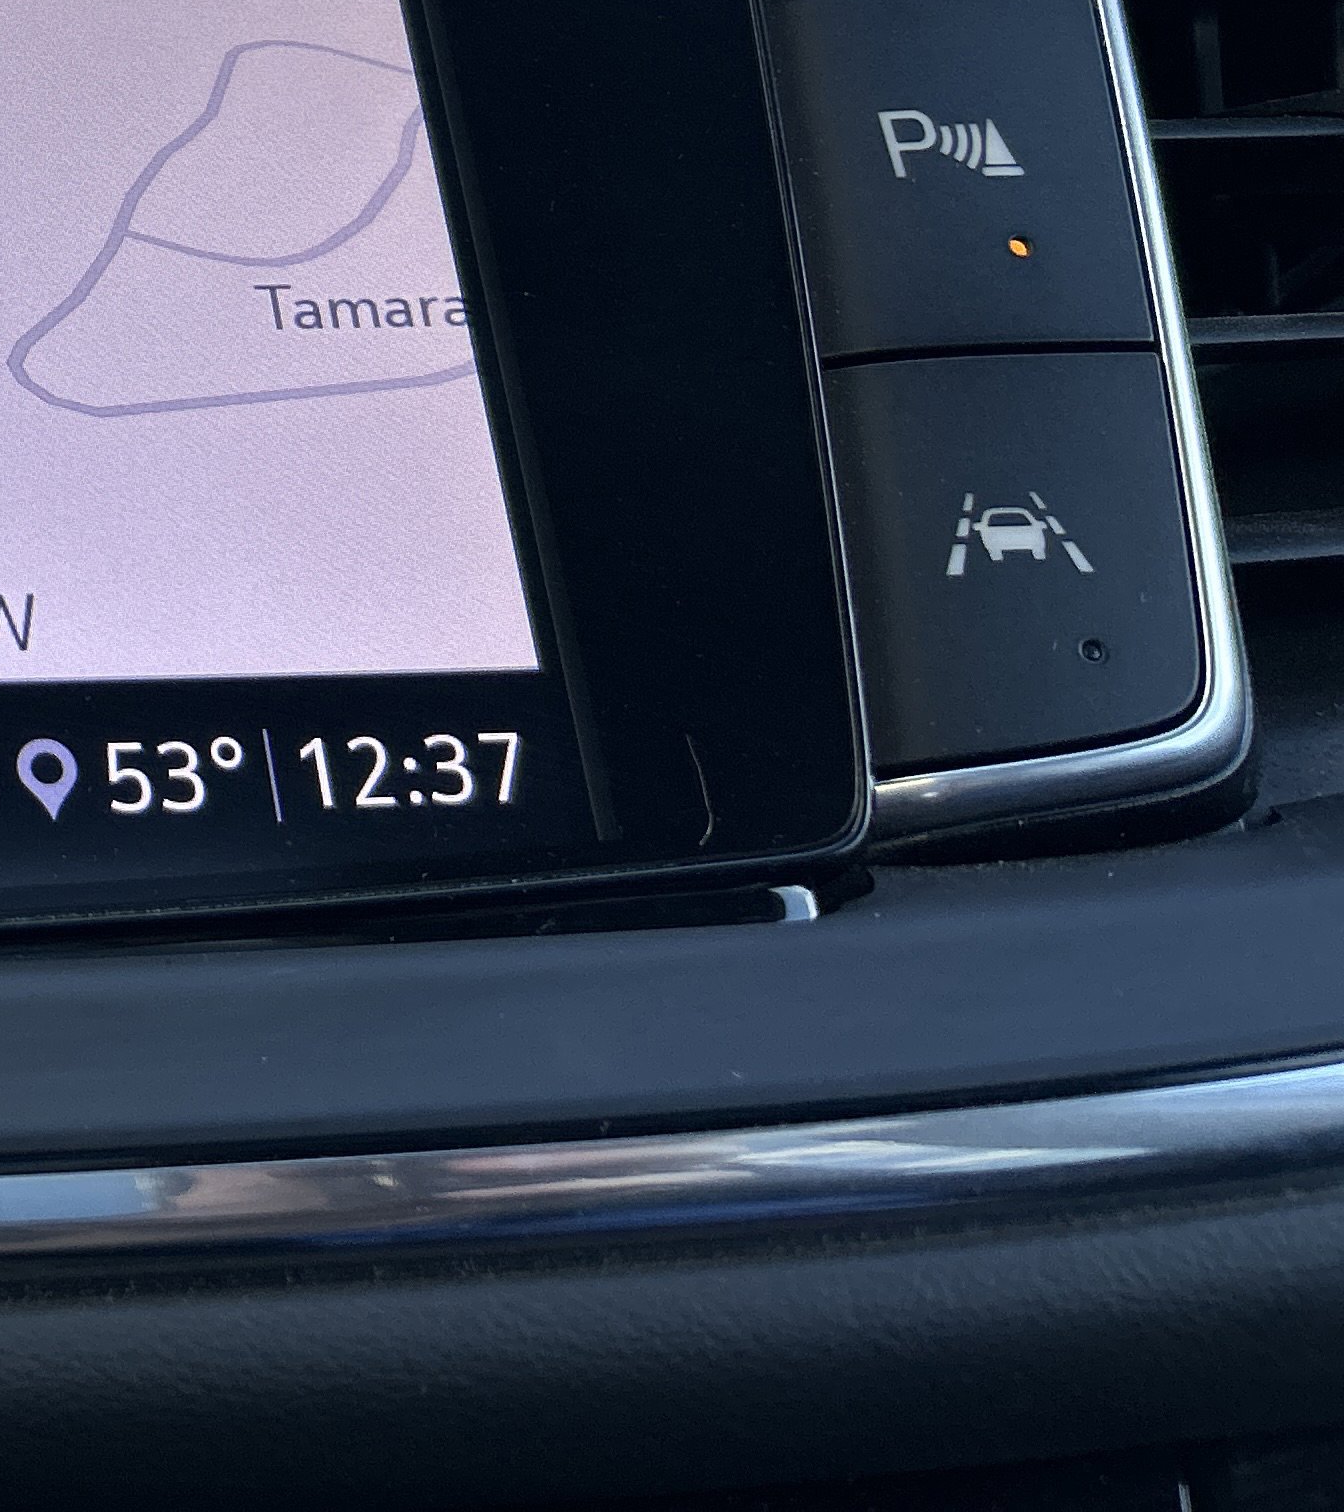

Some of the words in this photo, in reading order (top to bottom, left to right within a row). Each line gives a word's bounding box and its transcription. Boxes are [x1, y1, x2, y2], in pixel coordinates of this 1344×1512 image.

[877, 110, 932, 178] P
[107, 736, 244, 812] 53°
[298, 732, 520, 810] 12:37
